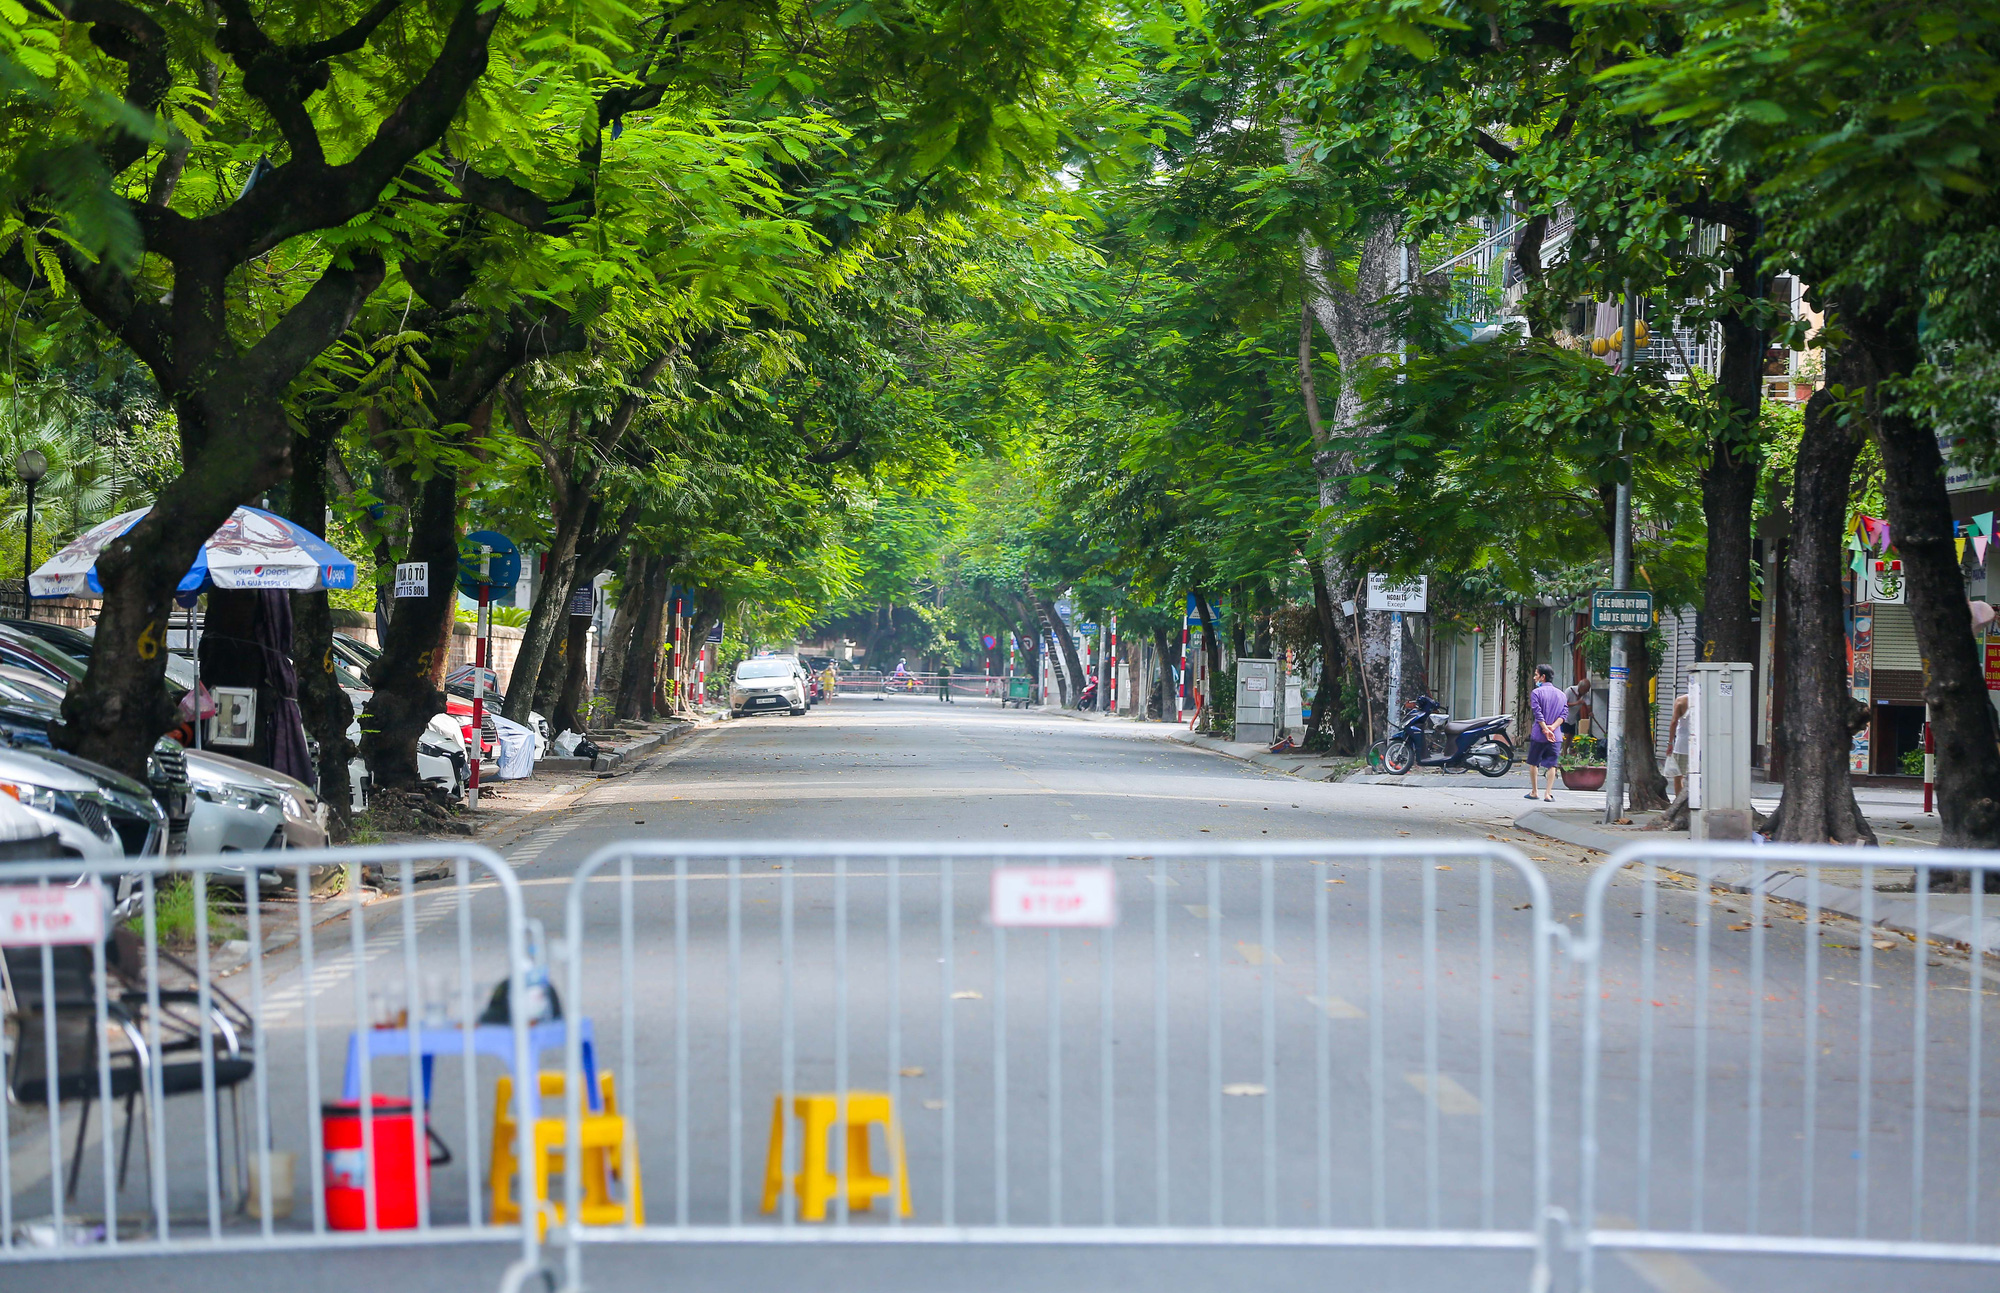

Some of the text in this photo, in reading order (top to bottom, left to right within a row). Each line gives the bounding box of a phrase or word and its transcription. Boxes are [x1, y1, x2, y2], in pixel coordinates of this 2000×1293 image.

[265, 568, 289, 578] pepsi
[415, 565, 425, 581] TÔ
[1612, 613, 1620, 622] XE
[1621, 613, 1636, 623] QUAY
